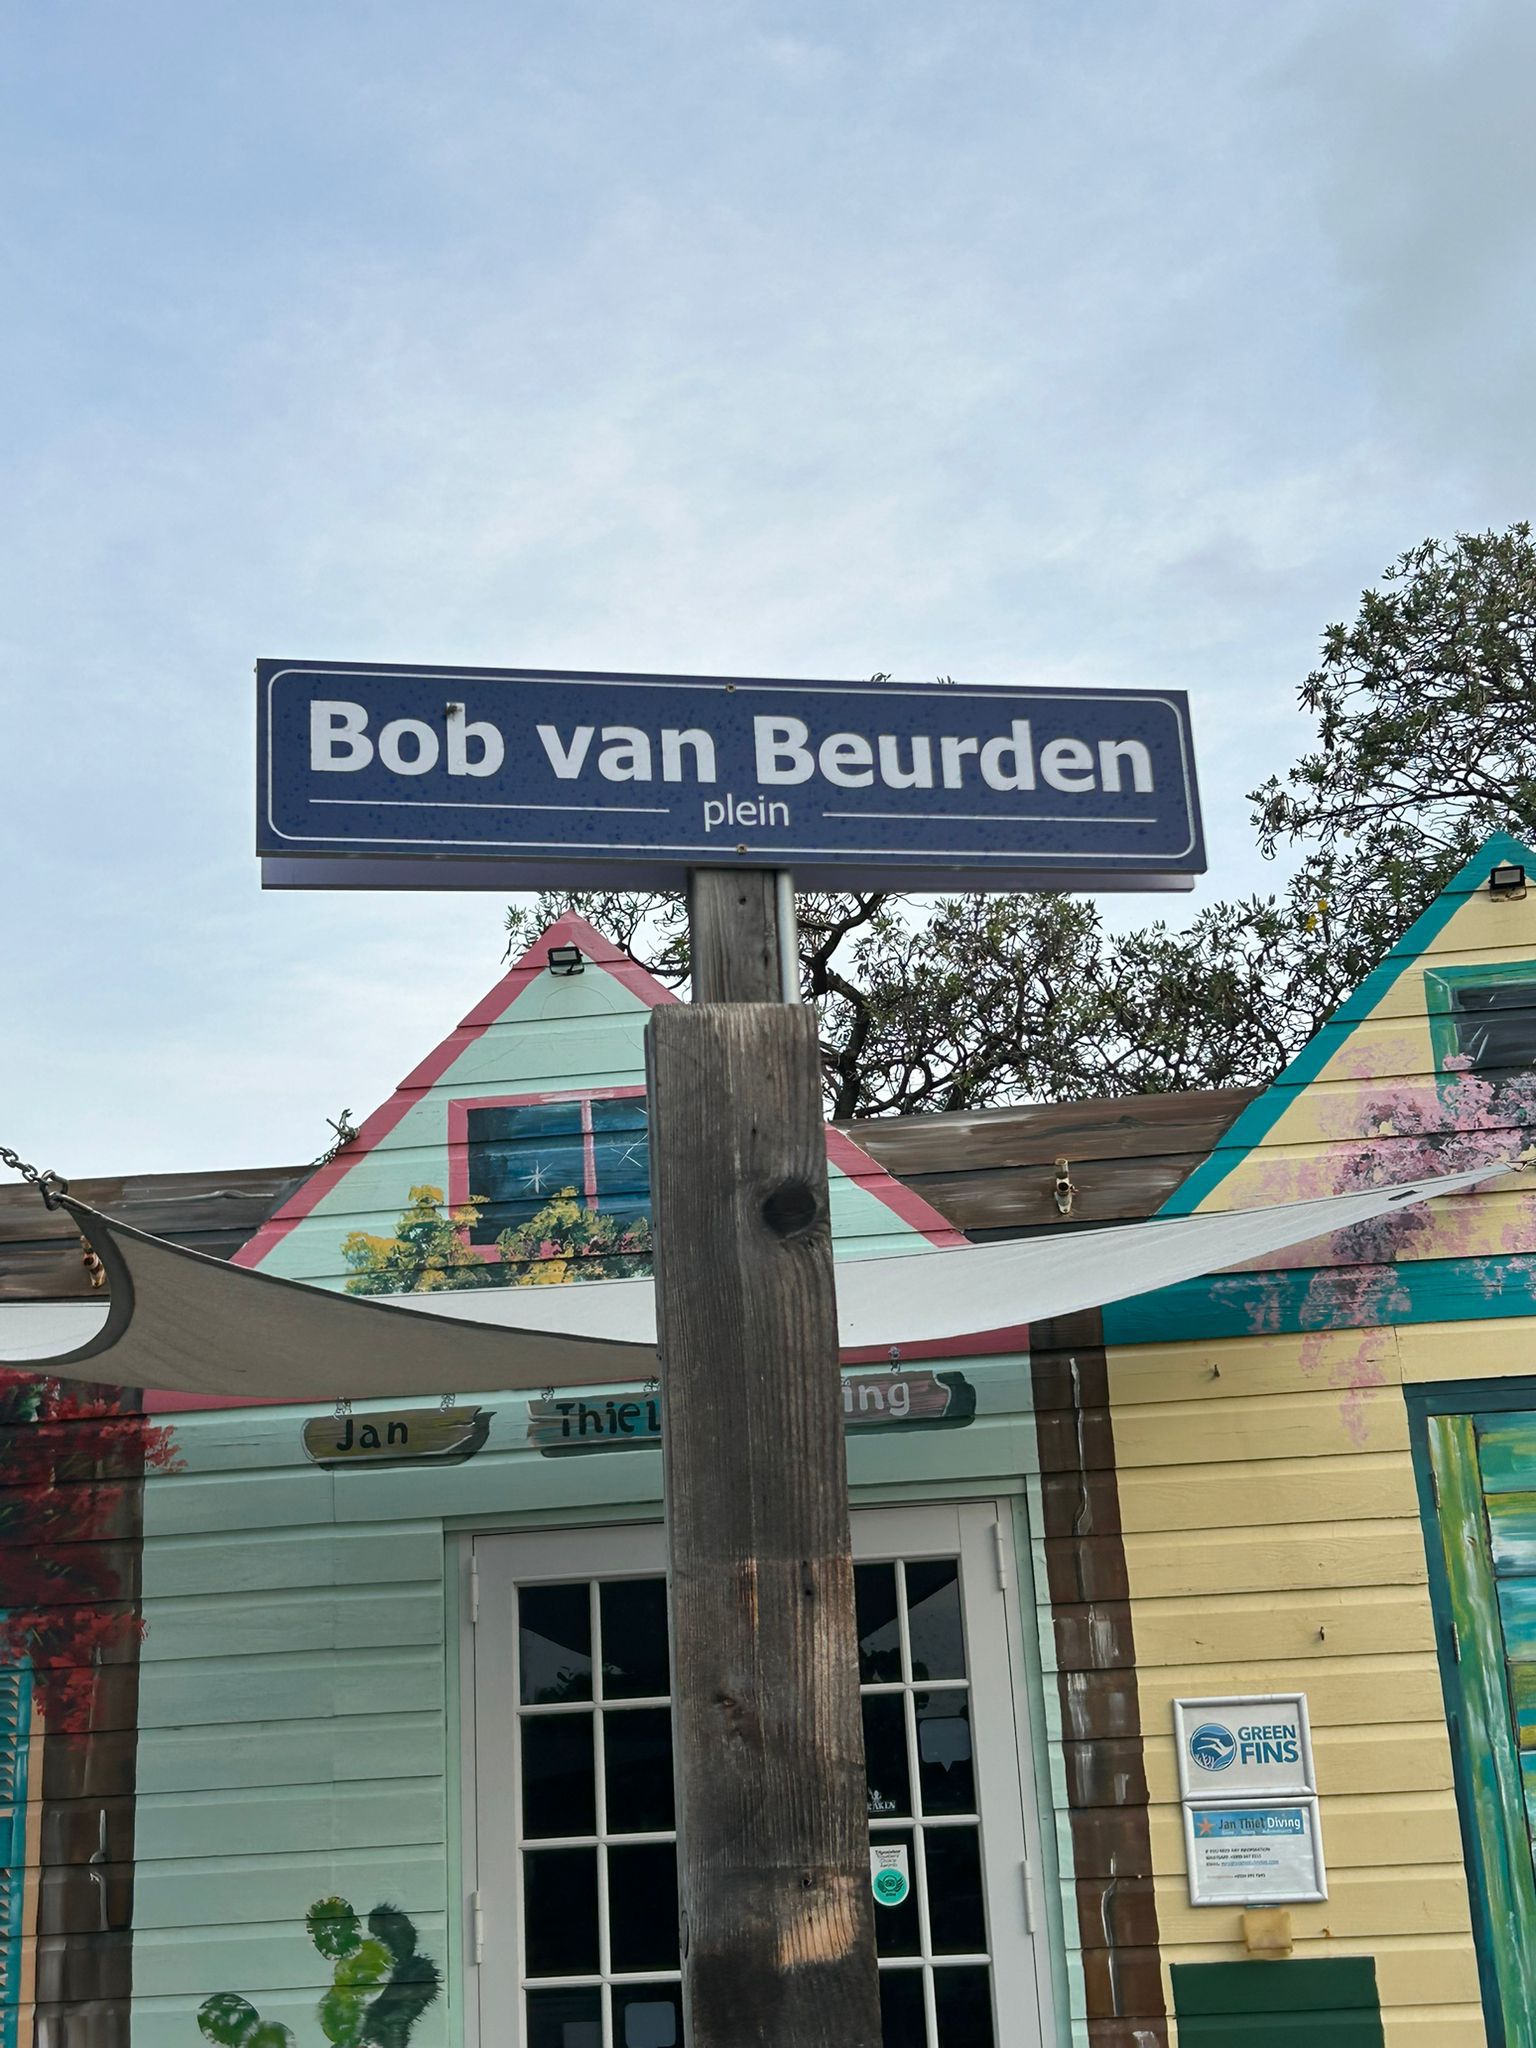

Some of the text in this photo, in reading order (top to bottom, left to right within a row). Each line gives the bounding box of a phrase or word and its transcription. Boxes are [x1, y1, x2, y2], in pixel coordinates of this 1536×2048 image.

[310, 700, 1154, 793] Bob van Beurden
[703, 793, 790, 832] plein
[336, 1419, 409, 1451] Jan
[842, 1381, 910, 1416] ing
[1237, 1724, 1297, 1741] GREEN
[1240, 1740, 1299, 1764] FINS
[1218, 1816, 1301, 1830] Jan Thiel Diving
